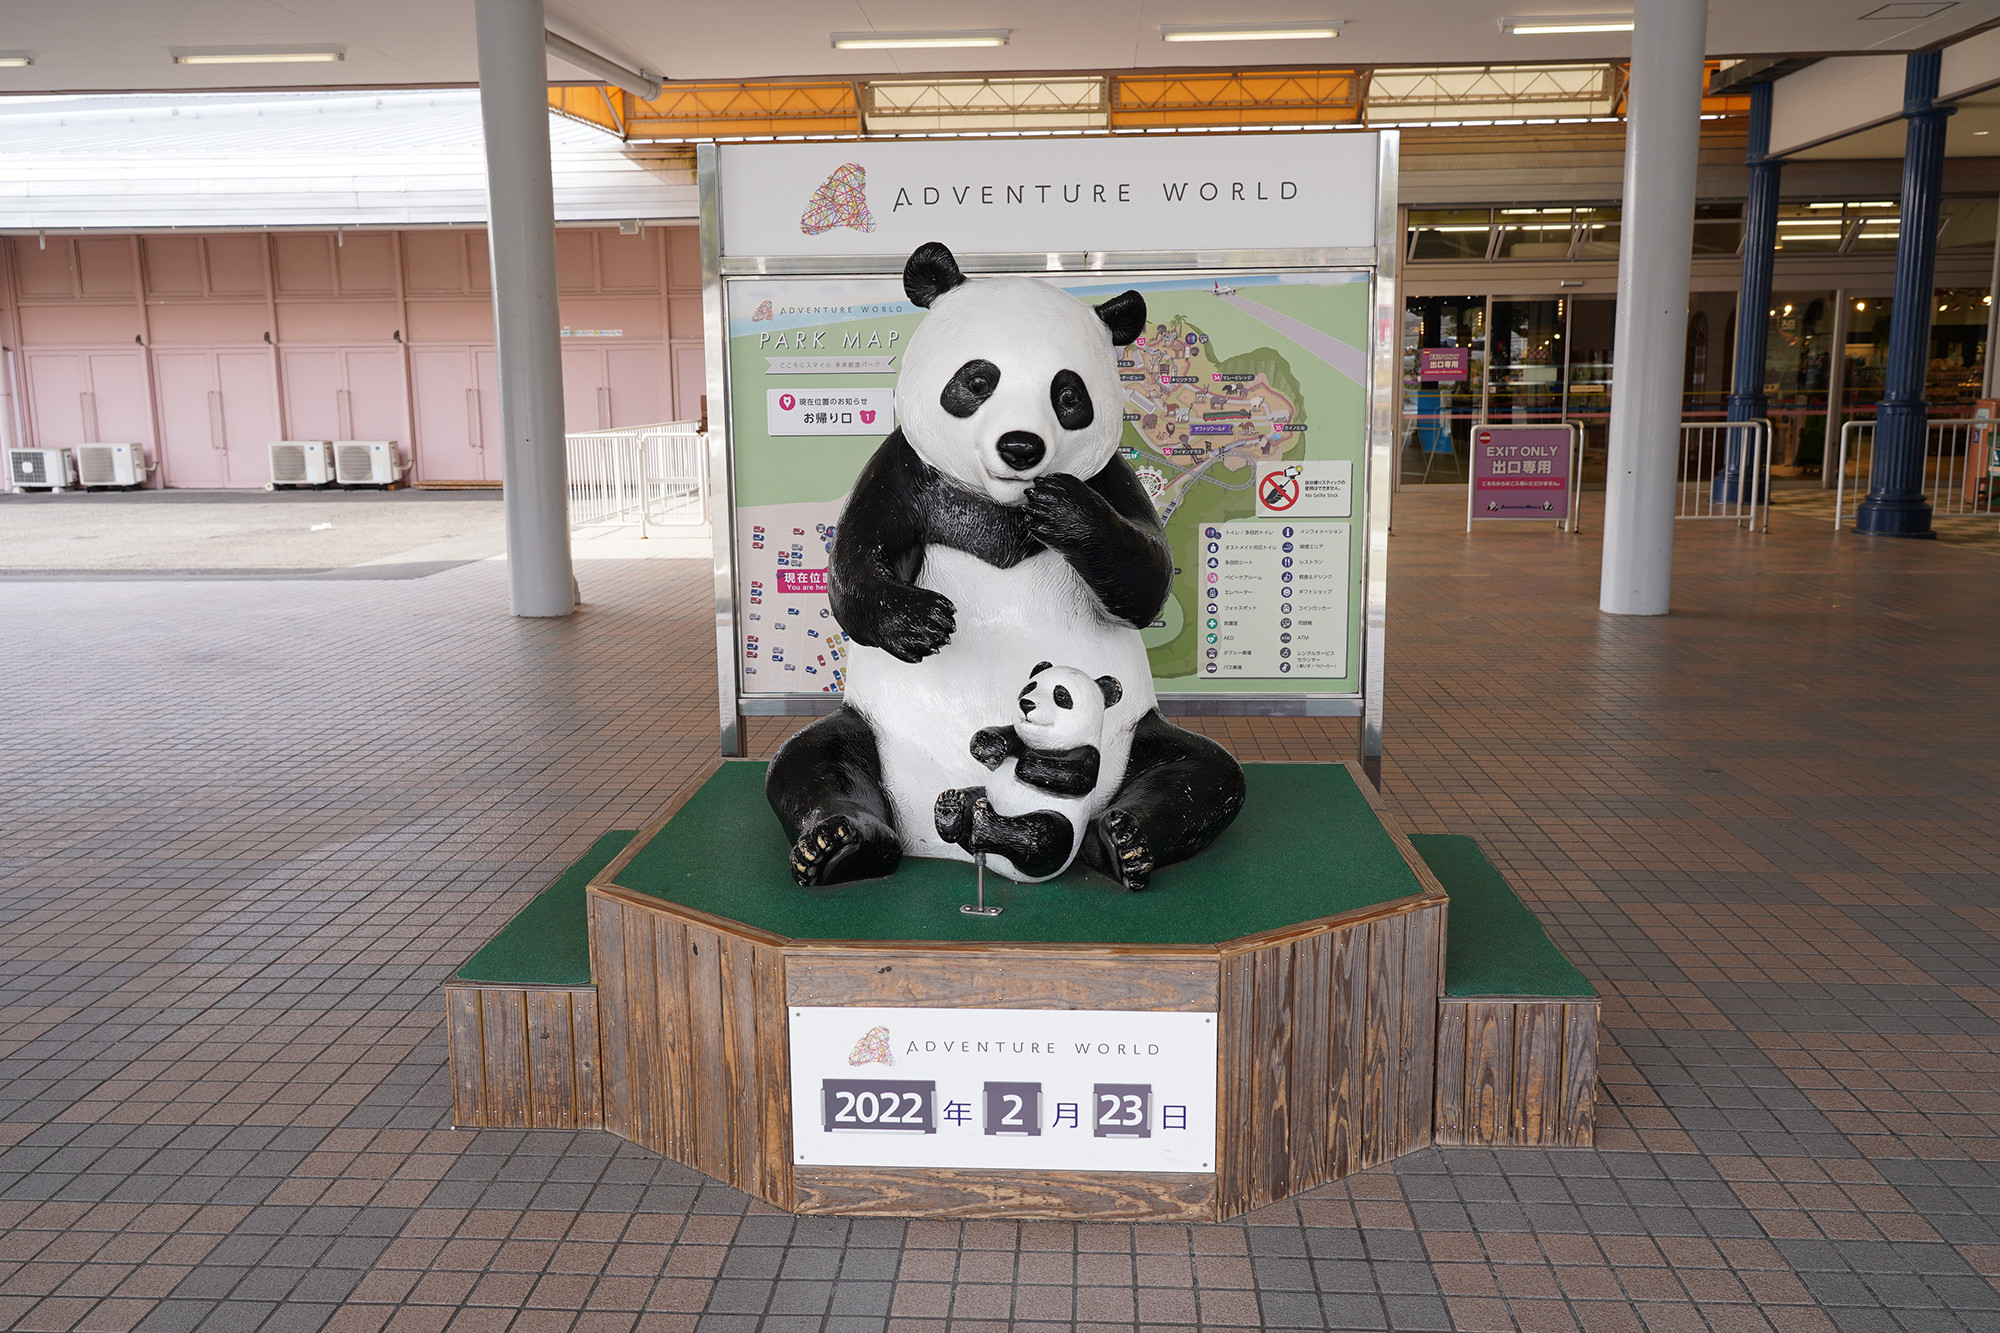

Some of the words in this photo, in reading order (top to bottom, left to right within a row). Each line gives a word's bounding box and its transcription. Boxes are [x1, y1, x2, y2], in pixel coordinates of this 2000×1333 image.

[892, 183, 1131, 213] ADVENTURE
[1162, 181, 1299, 203] WORLD
[780, 306, 852, 315] ADVENTURE
[861, 305, 903, 313] WORLD
[759, 331, 826, 350] PARK
[842, 330, 900, 349] MAP
[1429, 361, 1459, 369] 出口専用
[799, 398, 868, 406] 現在位置のお知らせ
[803, 412, 852, 425] お帰り口
[1486, 446, 1518, 457] EXIT
[1520, 446, 1558, 457] ONLY
[1492, 460, 1551, 475] 出口専用
[905, 1040, 1056, 1056] ADVENTURE
[1074, 1042, 1160, 1056] WORLD
[834, 1091, 924, 1124] 2022
[943, 1100, 973, 1127] 年
[1001, 1094, 1023, 1126] 2
[1052, 1102, 1079, 1128] 月
[1099, 1094, 1143, 1127] 23
[1163, 1105, 1187, 1130] 日
